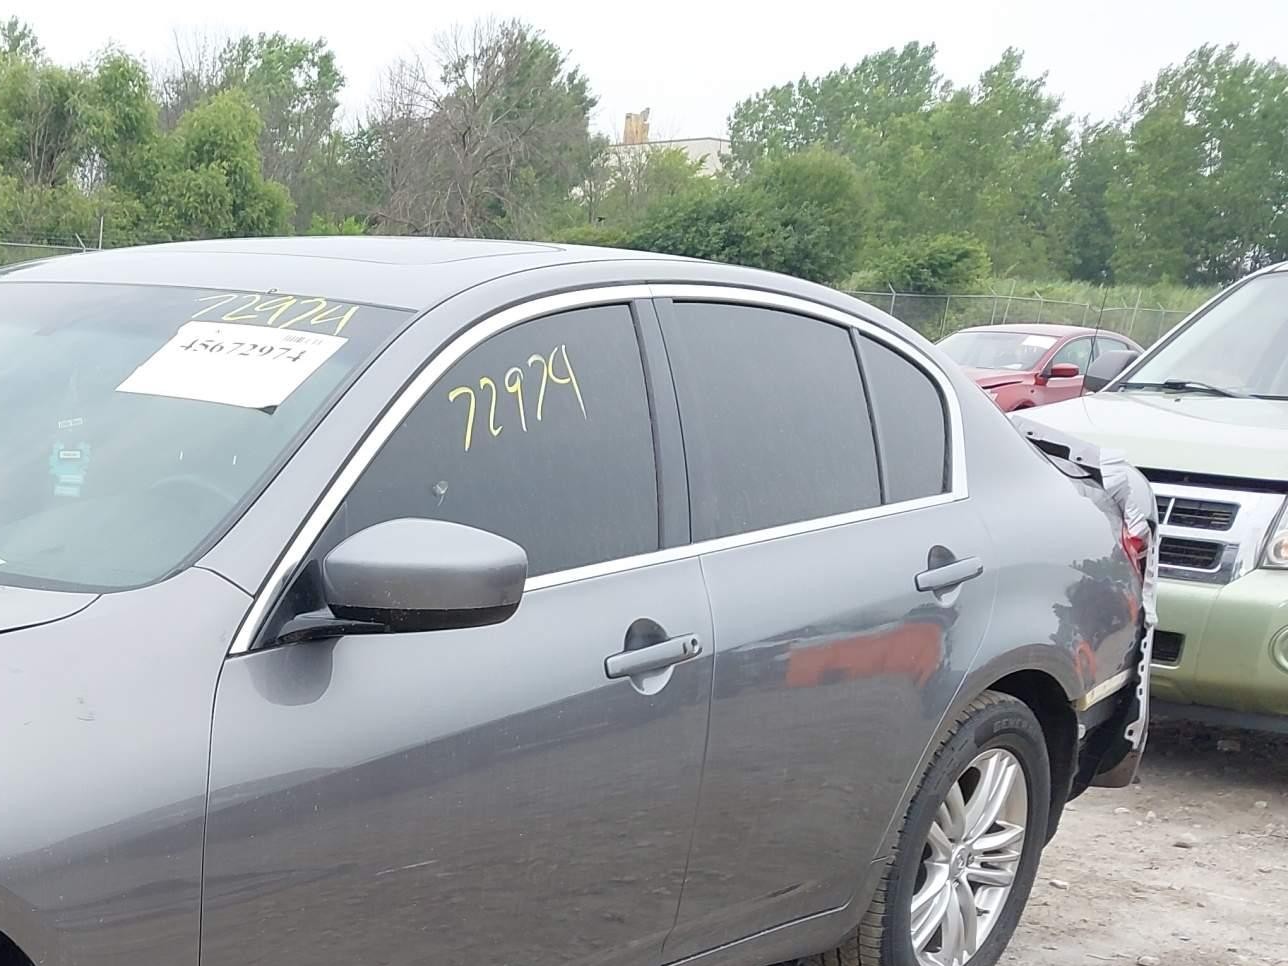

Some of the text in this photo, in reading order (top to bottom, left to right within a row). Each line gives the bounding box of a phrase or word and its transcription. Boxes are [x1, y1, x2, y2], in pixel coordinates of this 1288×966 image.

[191, 293, 360, 337] 72974
[179, 338, 306, 362] 45672974
[448, 344, 587, 452] 72974
